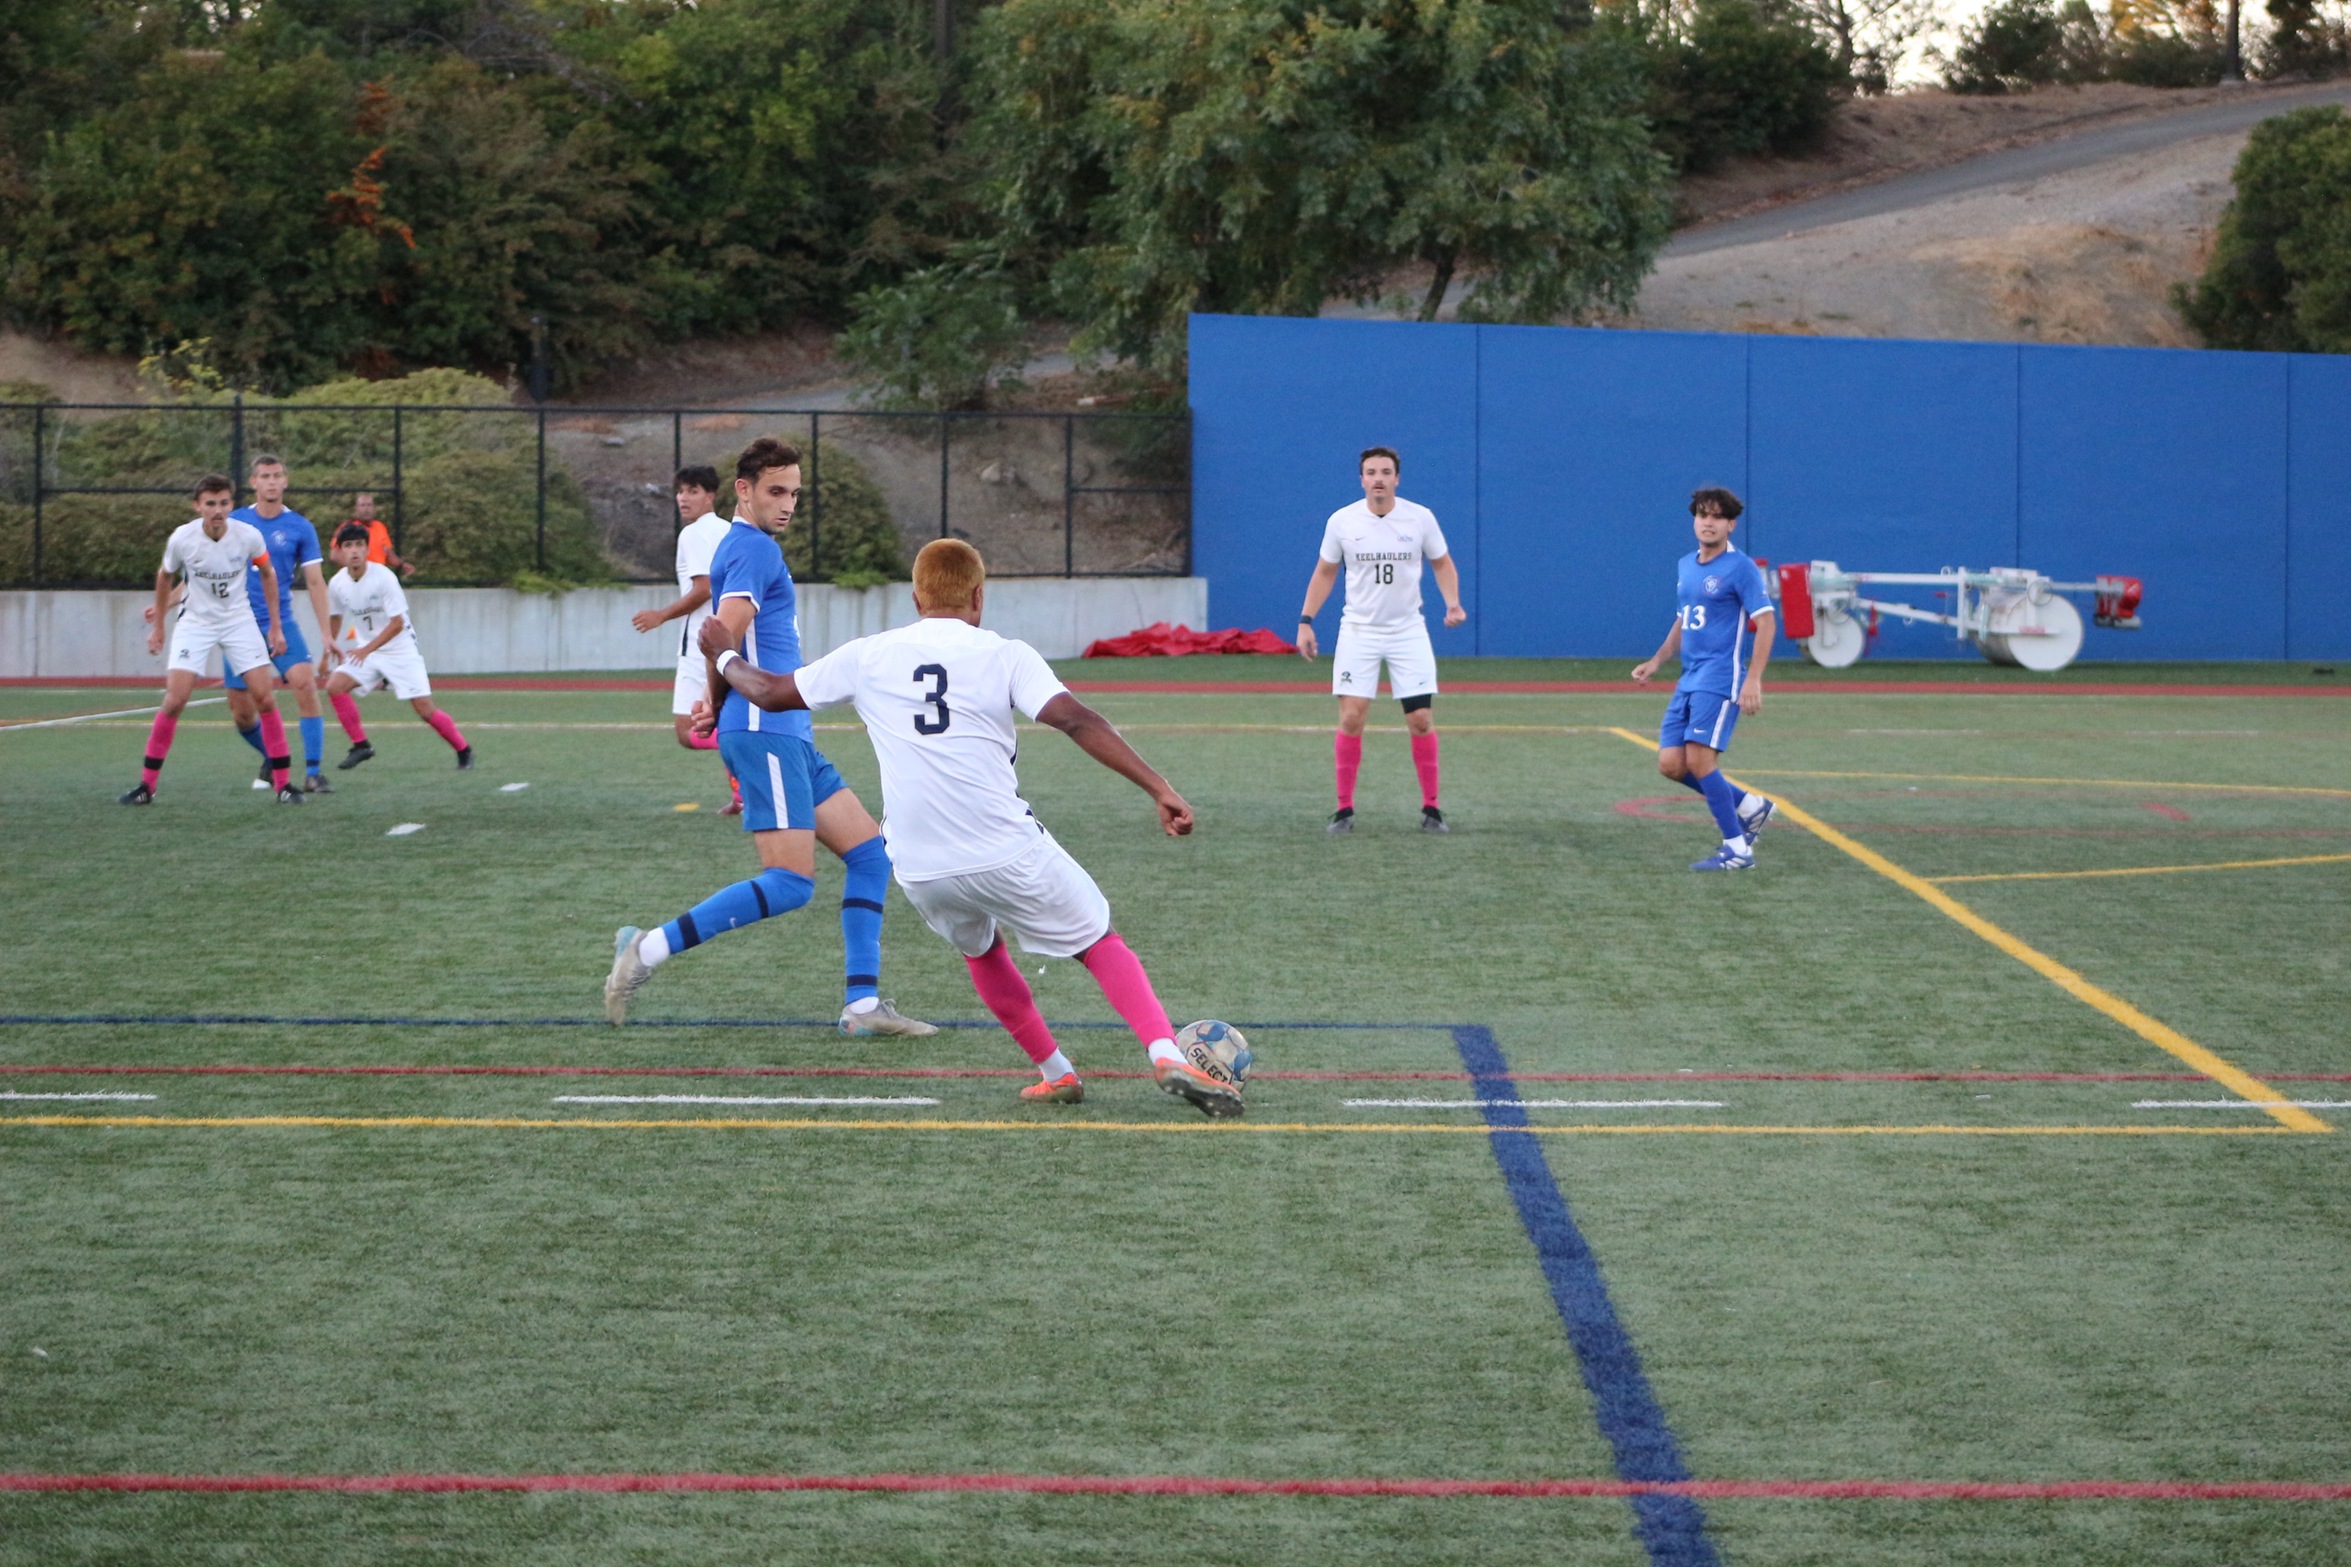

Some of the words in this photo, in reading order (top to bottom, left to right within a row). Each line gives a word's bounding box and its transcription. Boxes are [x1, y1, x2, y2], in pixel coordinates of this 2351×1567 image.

[1355, 552, 1412, 561] KEELHAULERS
[1374, 563, 1394, 585] 18
[211, 582, 230, 599] 12
[363, 615, 374, 631] 7
[1681, 604, 1706, 631] 13
[912, 663, 950, 735] 3
